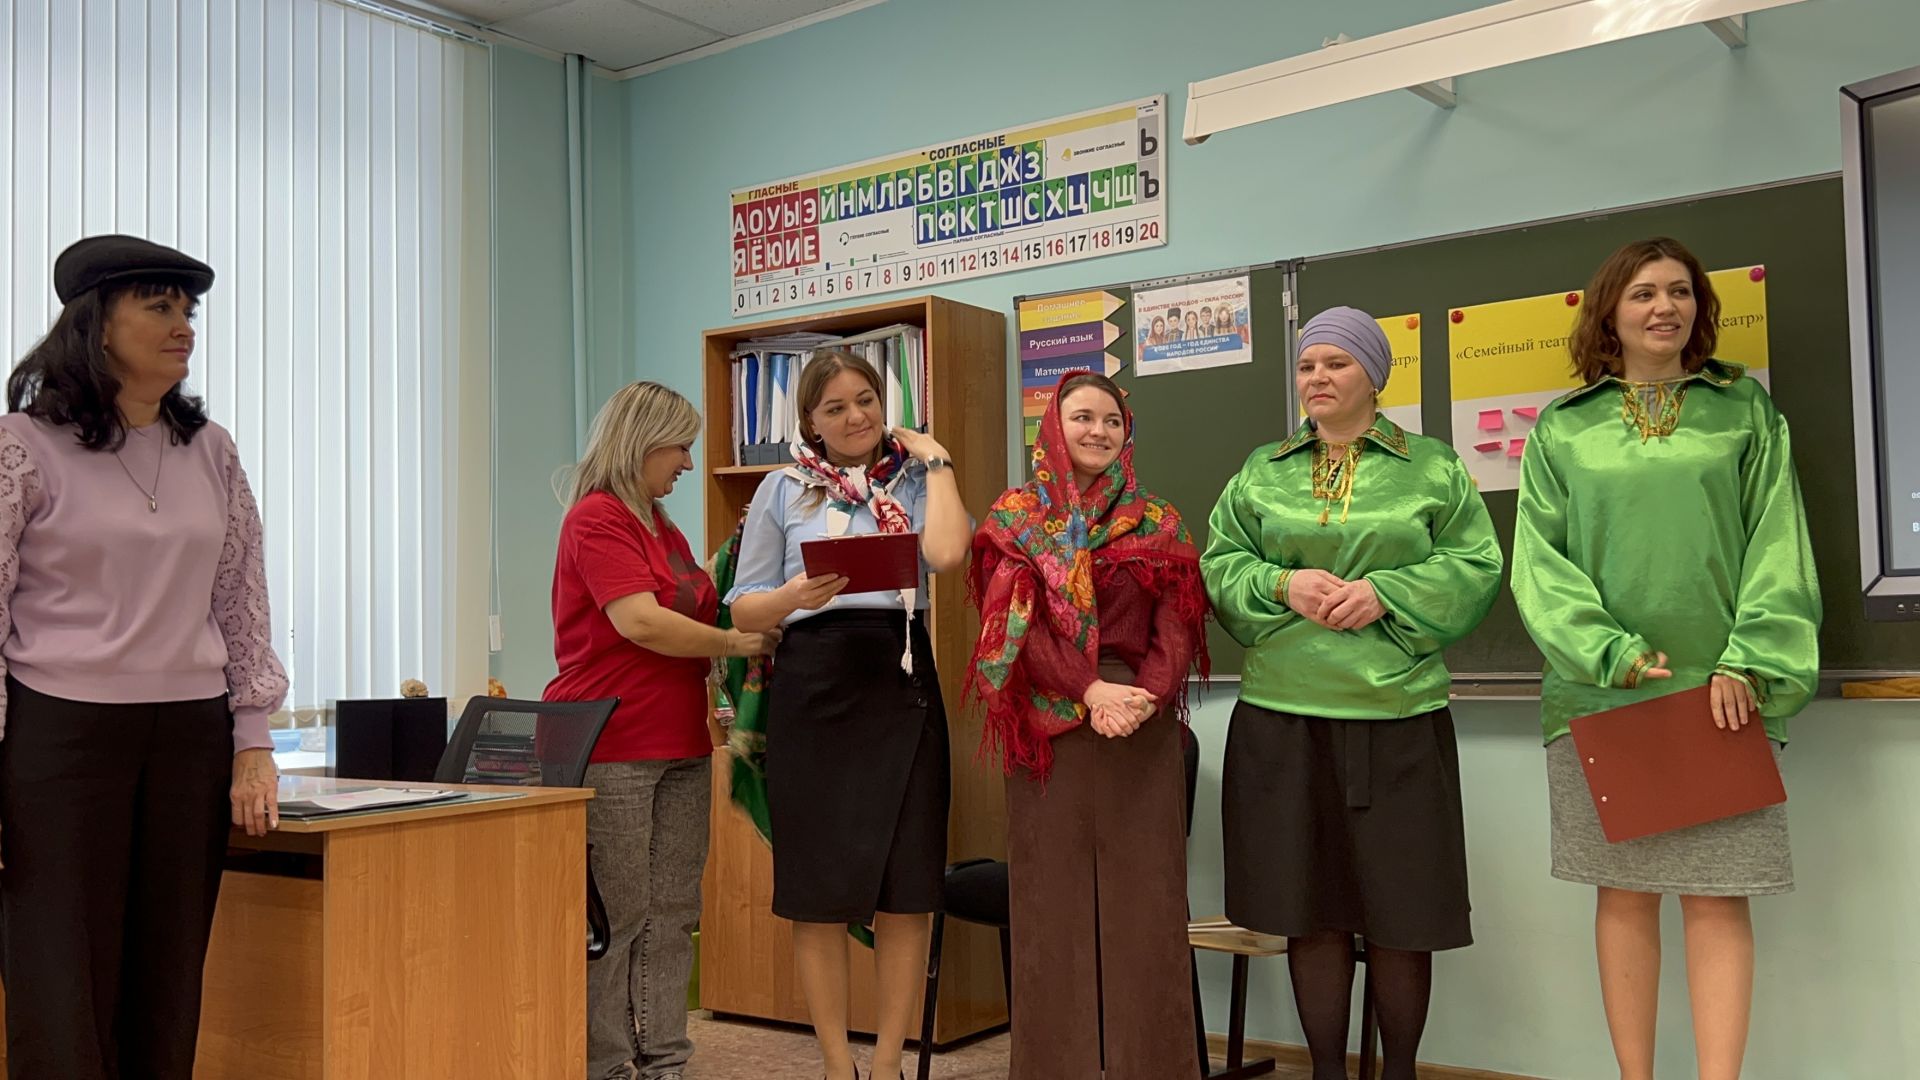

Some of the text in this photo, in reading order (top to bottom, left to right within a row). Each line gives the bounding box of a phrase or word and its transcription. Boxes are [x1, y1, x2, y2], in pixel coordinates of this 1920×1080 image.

[930, 135, 1006, 161] СОГЛАСНЫЕ
[1096, 141, 1125, 151] СОГЛАСНЫЕ
[1141, 128, 1158, 156] Ь
[748, 181, 799, 200] ГЛАСНЫЕ
[821, 152, 1040, 224] Й Н М Л Р Б В Г Д Ж З
[1140, 170, 1159, 199] Ъ
[734, 198, 816, 238] А О У Ы Э
[918, 174, 1137, 241] П Ф К Т Ш С Х Ц Ч Щ
[974, 231, 1004, 240] СОГЛАСНЫЕ
[734, 235, 816, 274] Я Ё Ю И Е
[738, 222, 1159, 308] 0 1 2 3 4 5 6 7 8 9 10 11 12 13 14 15 16 17 18 19 20
[1720, 314, 1764, 328] еатр»
[1030, 333, 1094, 350] Русский язык
[1456, 338, 1534, 360] «Семейный
[1035, 365, 1090, 377] Математика
[1391, 355, 1419, 368] атр»
[1034, 392, 1054, 400] Окр
